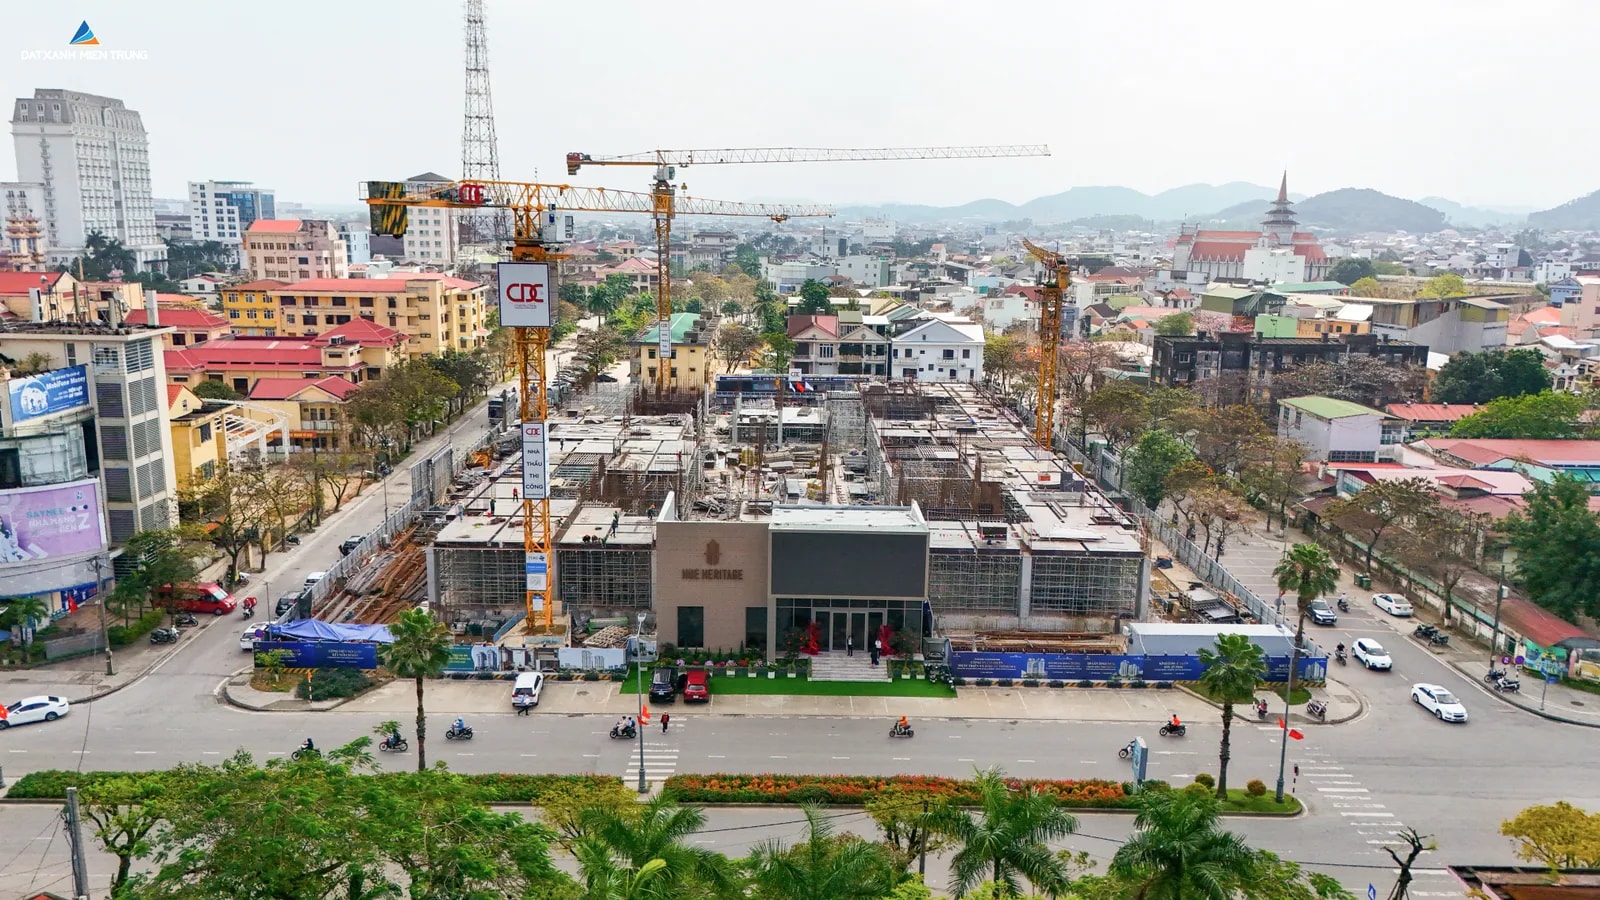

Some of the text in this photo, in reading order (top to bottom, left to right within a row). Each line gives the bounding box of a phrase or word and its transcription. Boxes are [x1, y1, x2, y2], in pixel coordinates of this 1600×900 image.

[506, 283, 544, 303] CDC
[681, 568, 743, 580] HUE HERITAGE
